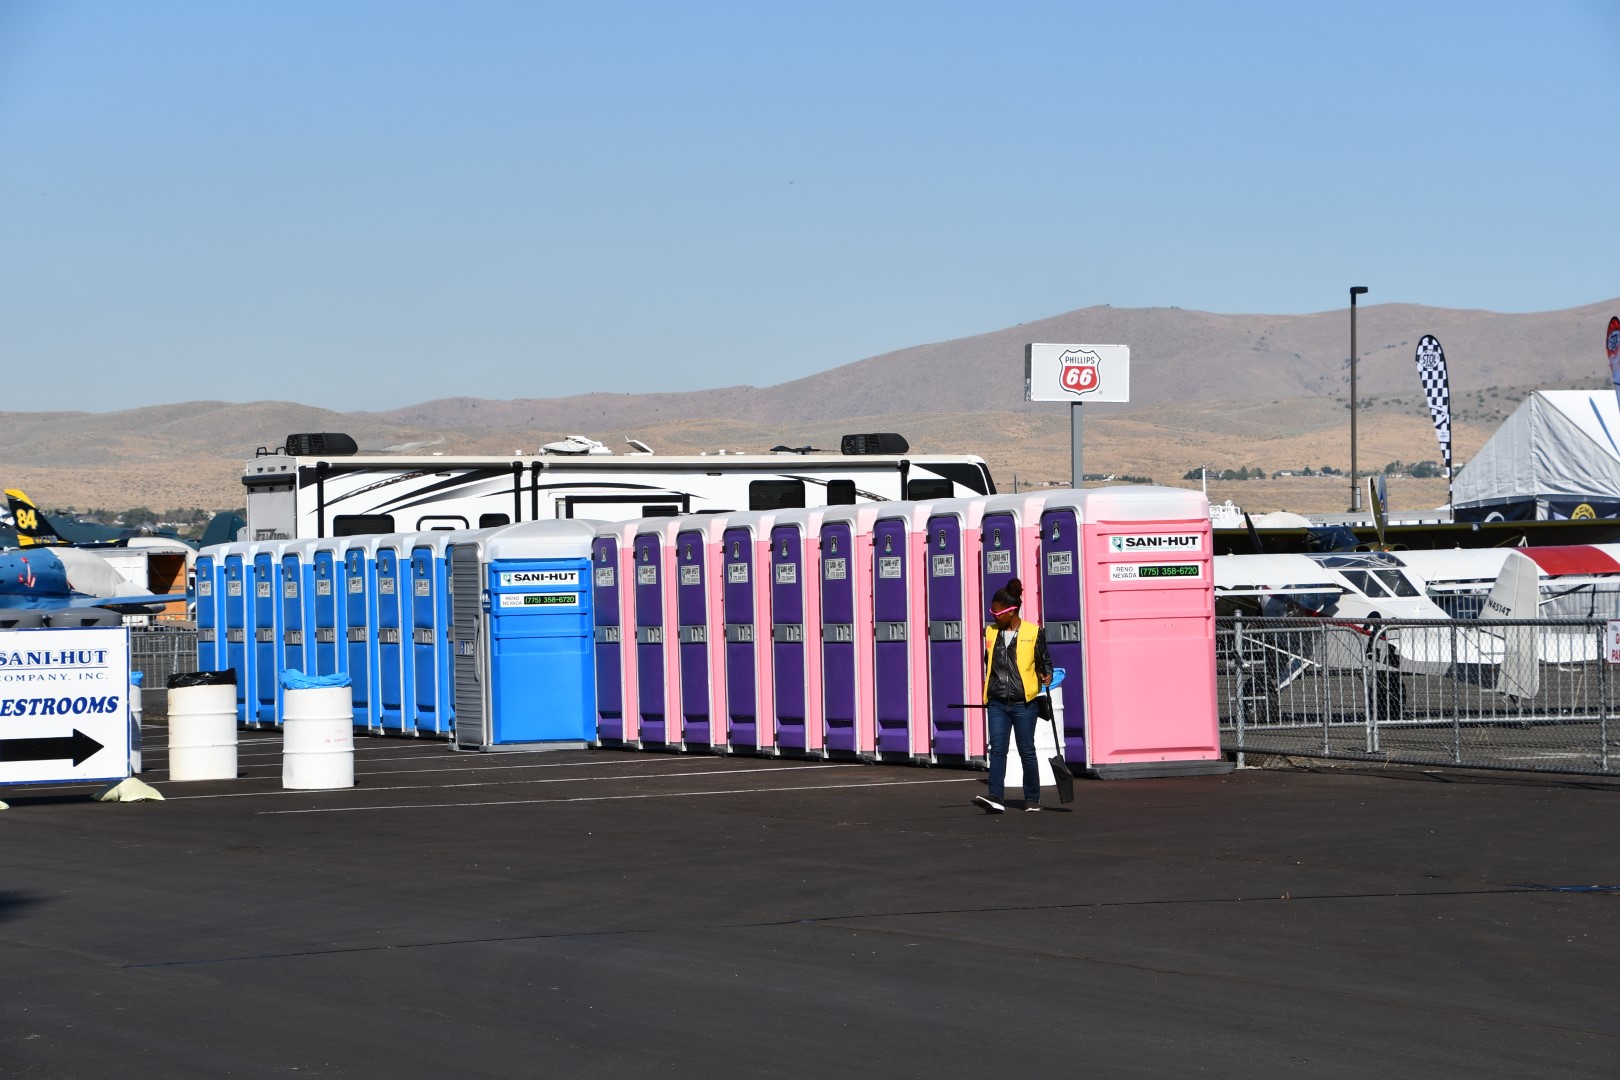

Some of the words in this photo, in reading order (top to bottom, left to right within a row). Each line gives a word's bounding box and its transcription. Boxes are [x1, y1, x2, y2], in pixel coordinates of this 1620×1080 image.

[1065, 356, 1095, 364] PHILLIPS
[1066, 368, 1093, 386] 66
[16, 509, 38, 529] 84
[1125, 536, 1198, 547] SANI-HUT
[1140, 568, 1159, 576] (775)
[1162, 566, 1197, 575] 358-6720
[514, 573, 576, 582] SANI-HUT
[525, 596, 541, 604] (775)
[0, 650, 108, 666] SANI-HUT
[79, 672, 109, 680] INC.
